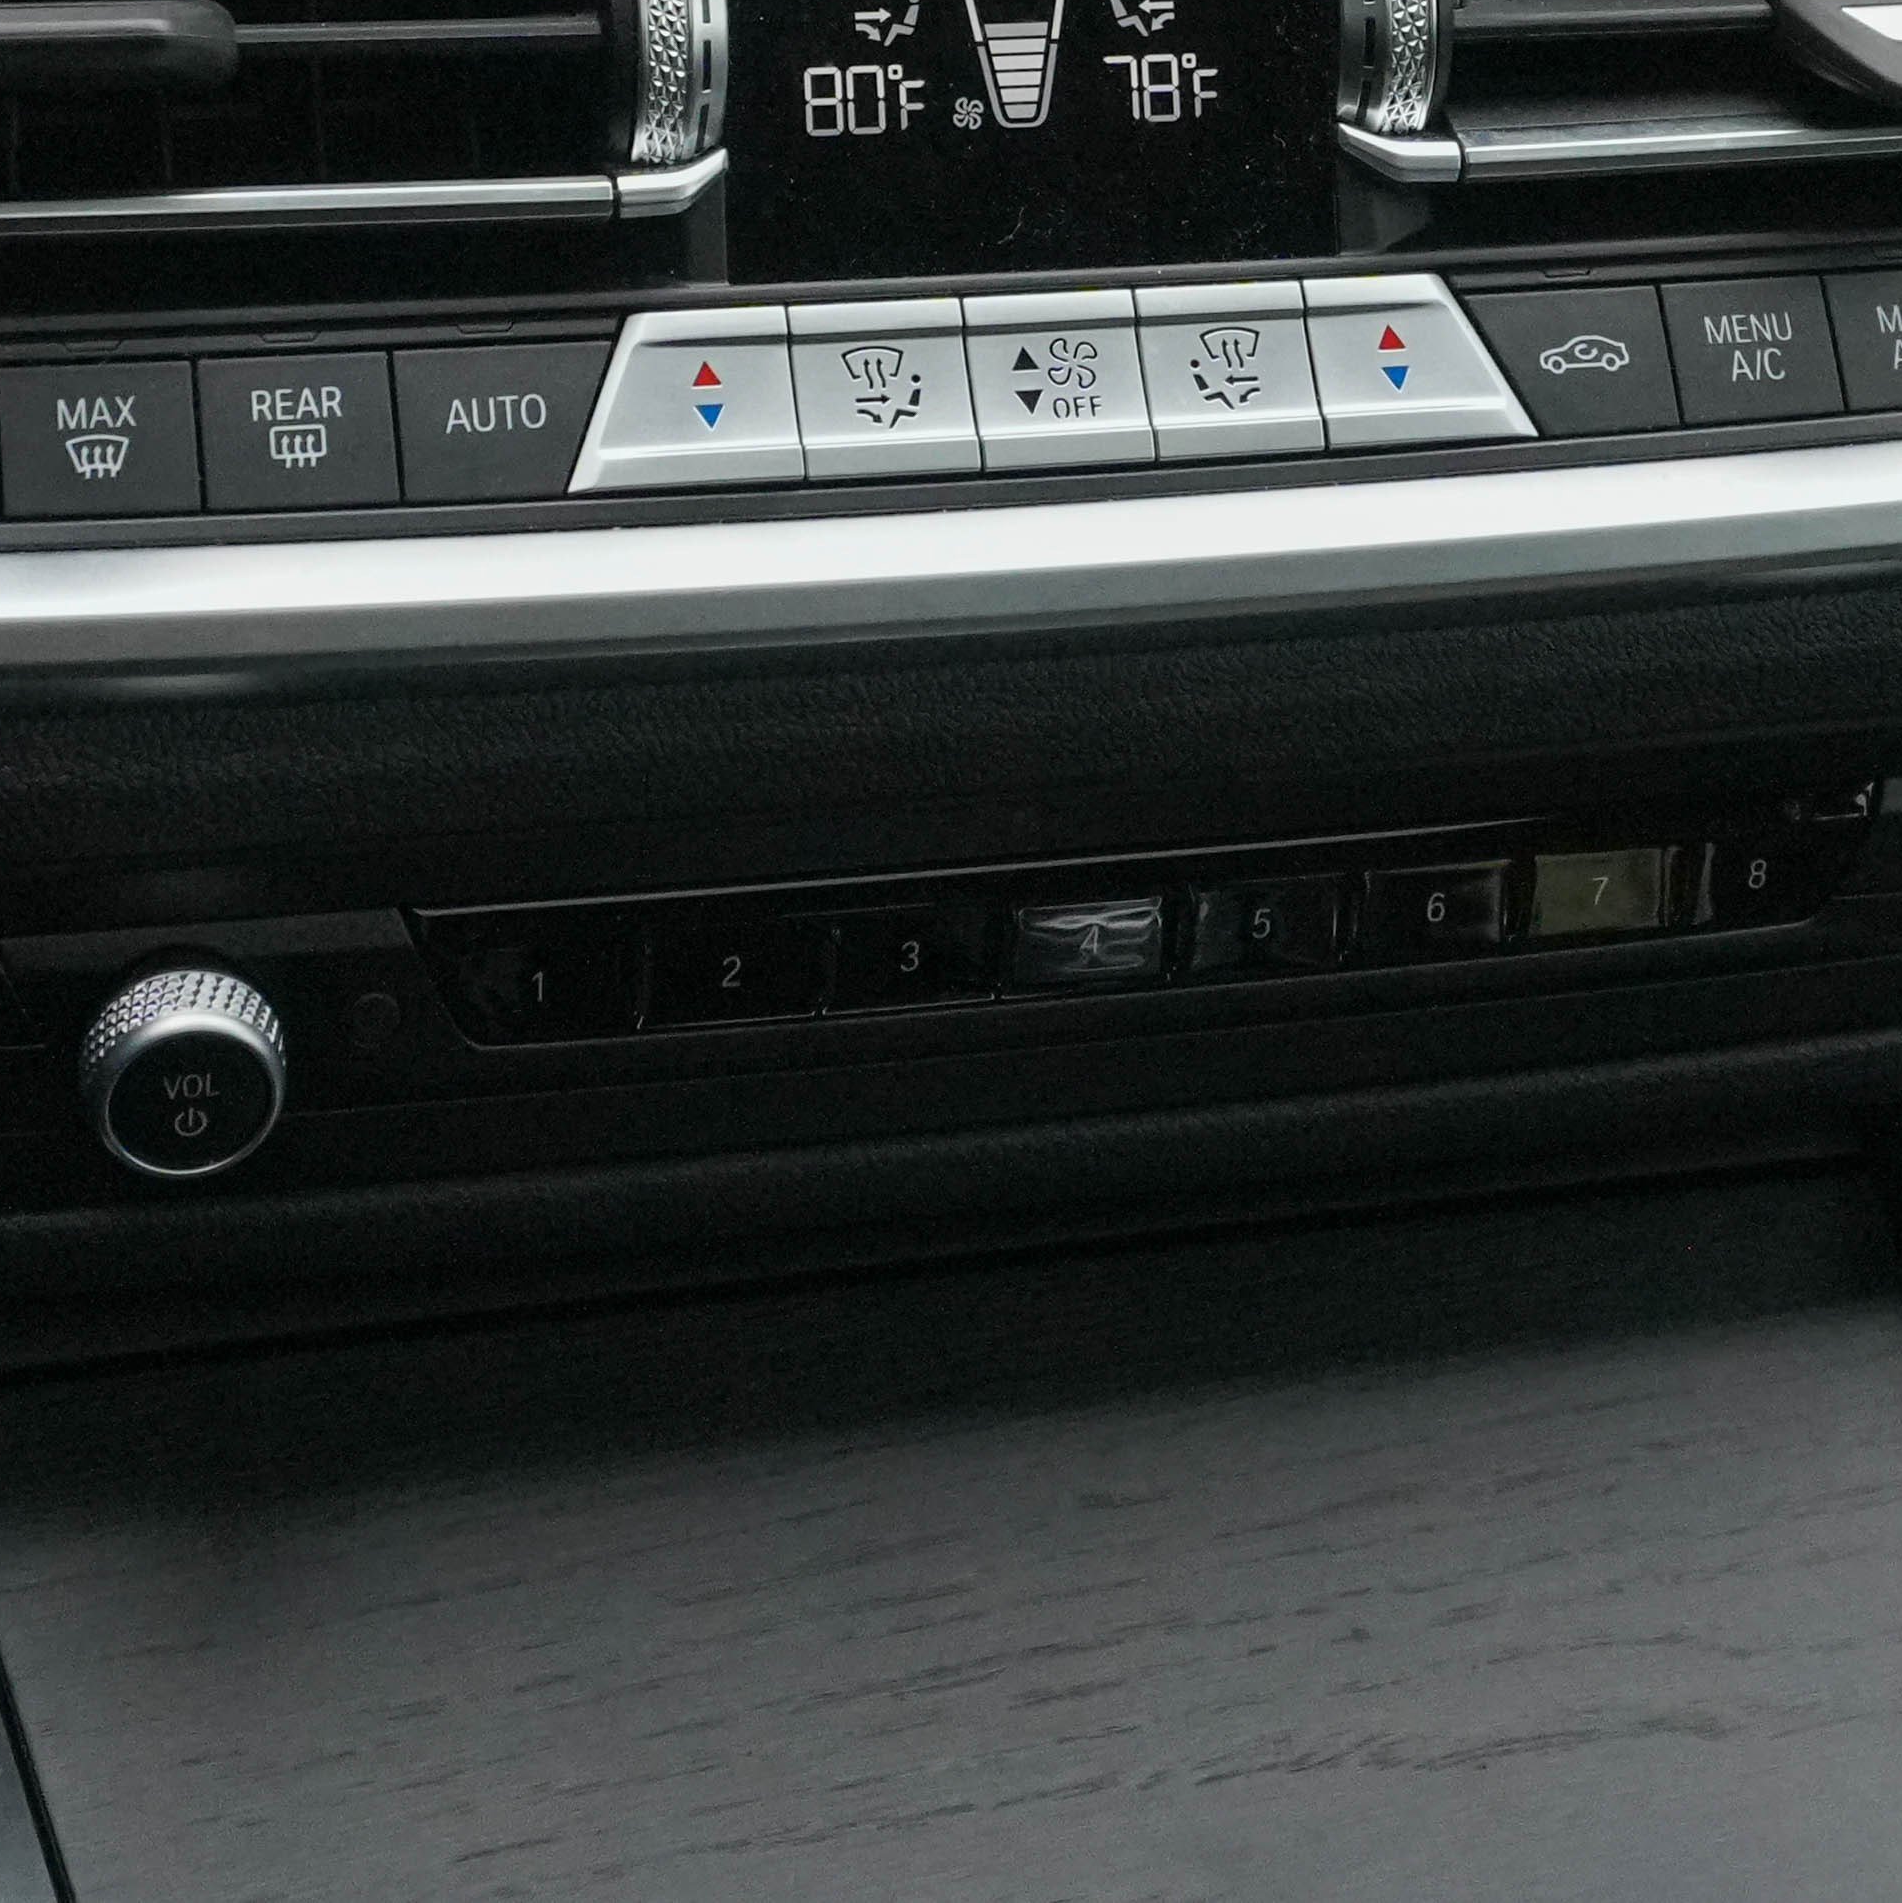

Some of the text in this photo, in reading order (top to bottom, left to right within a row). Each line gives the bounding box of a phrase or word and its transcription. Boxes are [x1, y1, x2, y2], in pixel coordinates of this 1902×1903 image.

[1703, 312, 1794, 346] MENU
[1730, 348, 1787, 383] A/C
[55, 394, 138, 430] MAX
[250, 384, 344, 421] REAR
[444, 392, 548, 435] AUTO
[1052, 393, 1103, 421] OFF
[1589, 876, 1611, 907] 7
[1746, 860, 1768, 891] 8
[1251, 908, 1273, 940] 5
[1425, 892, 1447, 924] 6
[899, 938, 921, 973] 3
[1079, 925, 1101, 958] 4
[531, 971, 547, 1004] 1
[720, 953, 742, 989] 2
[162, 1074, 220, 1102] VOL
